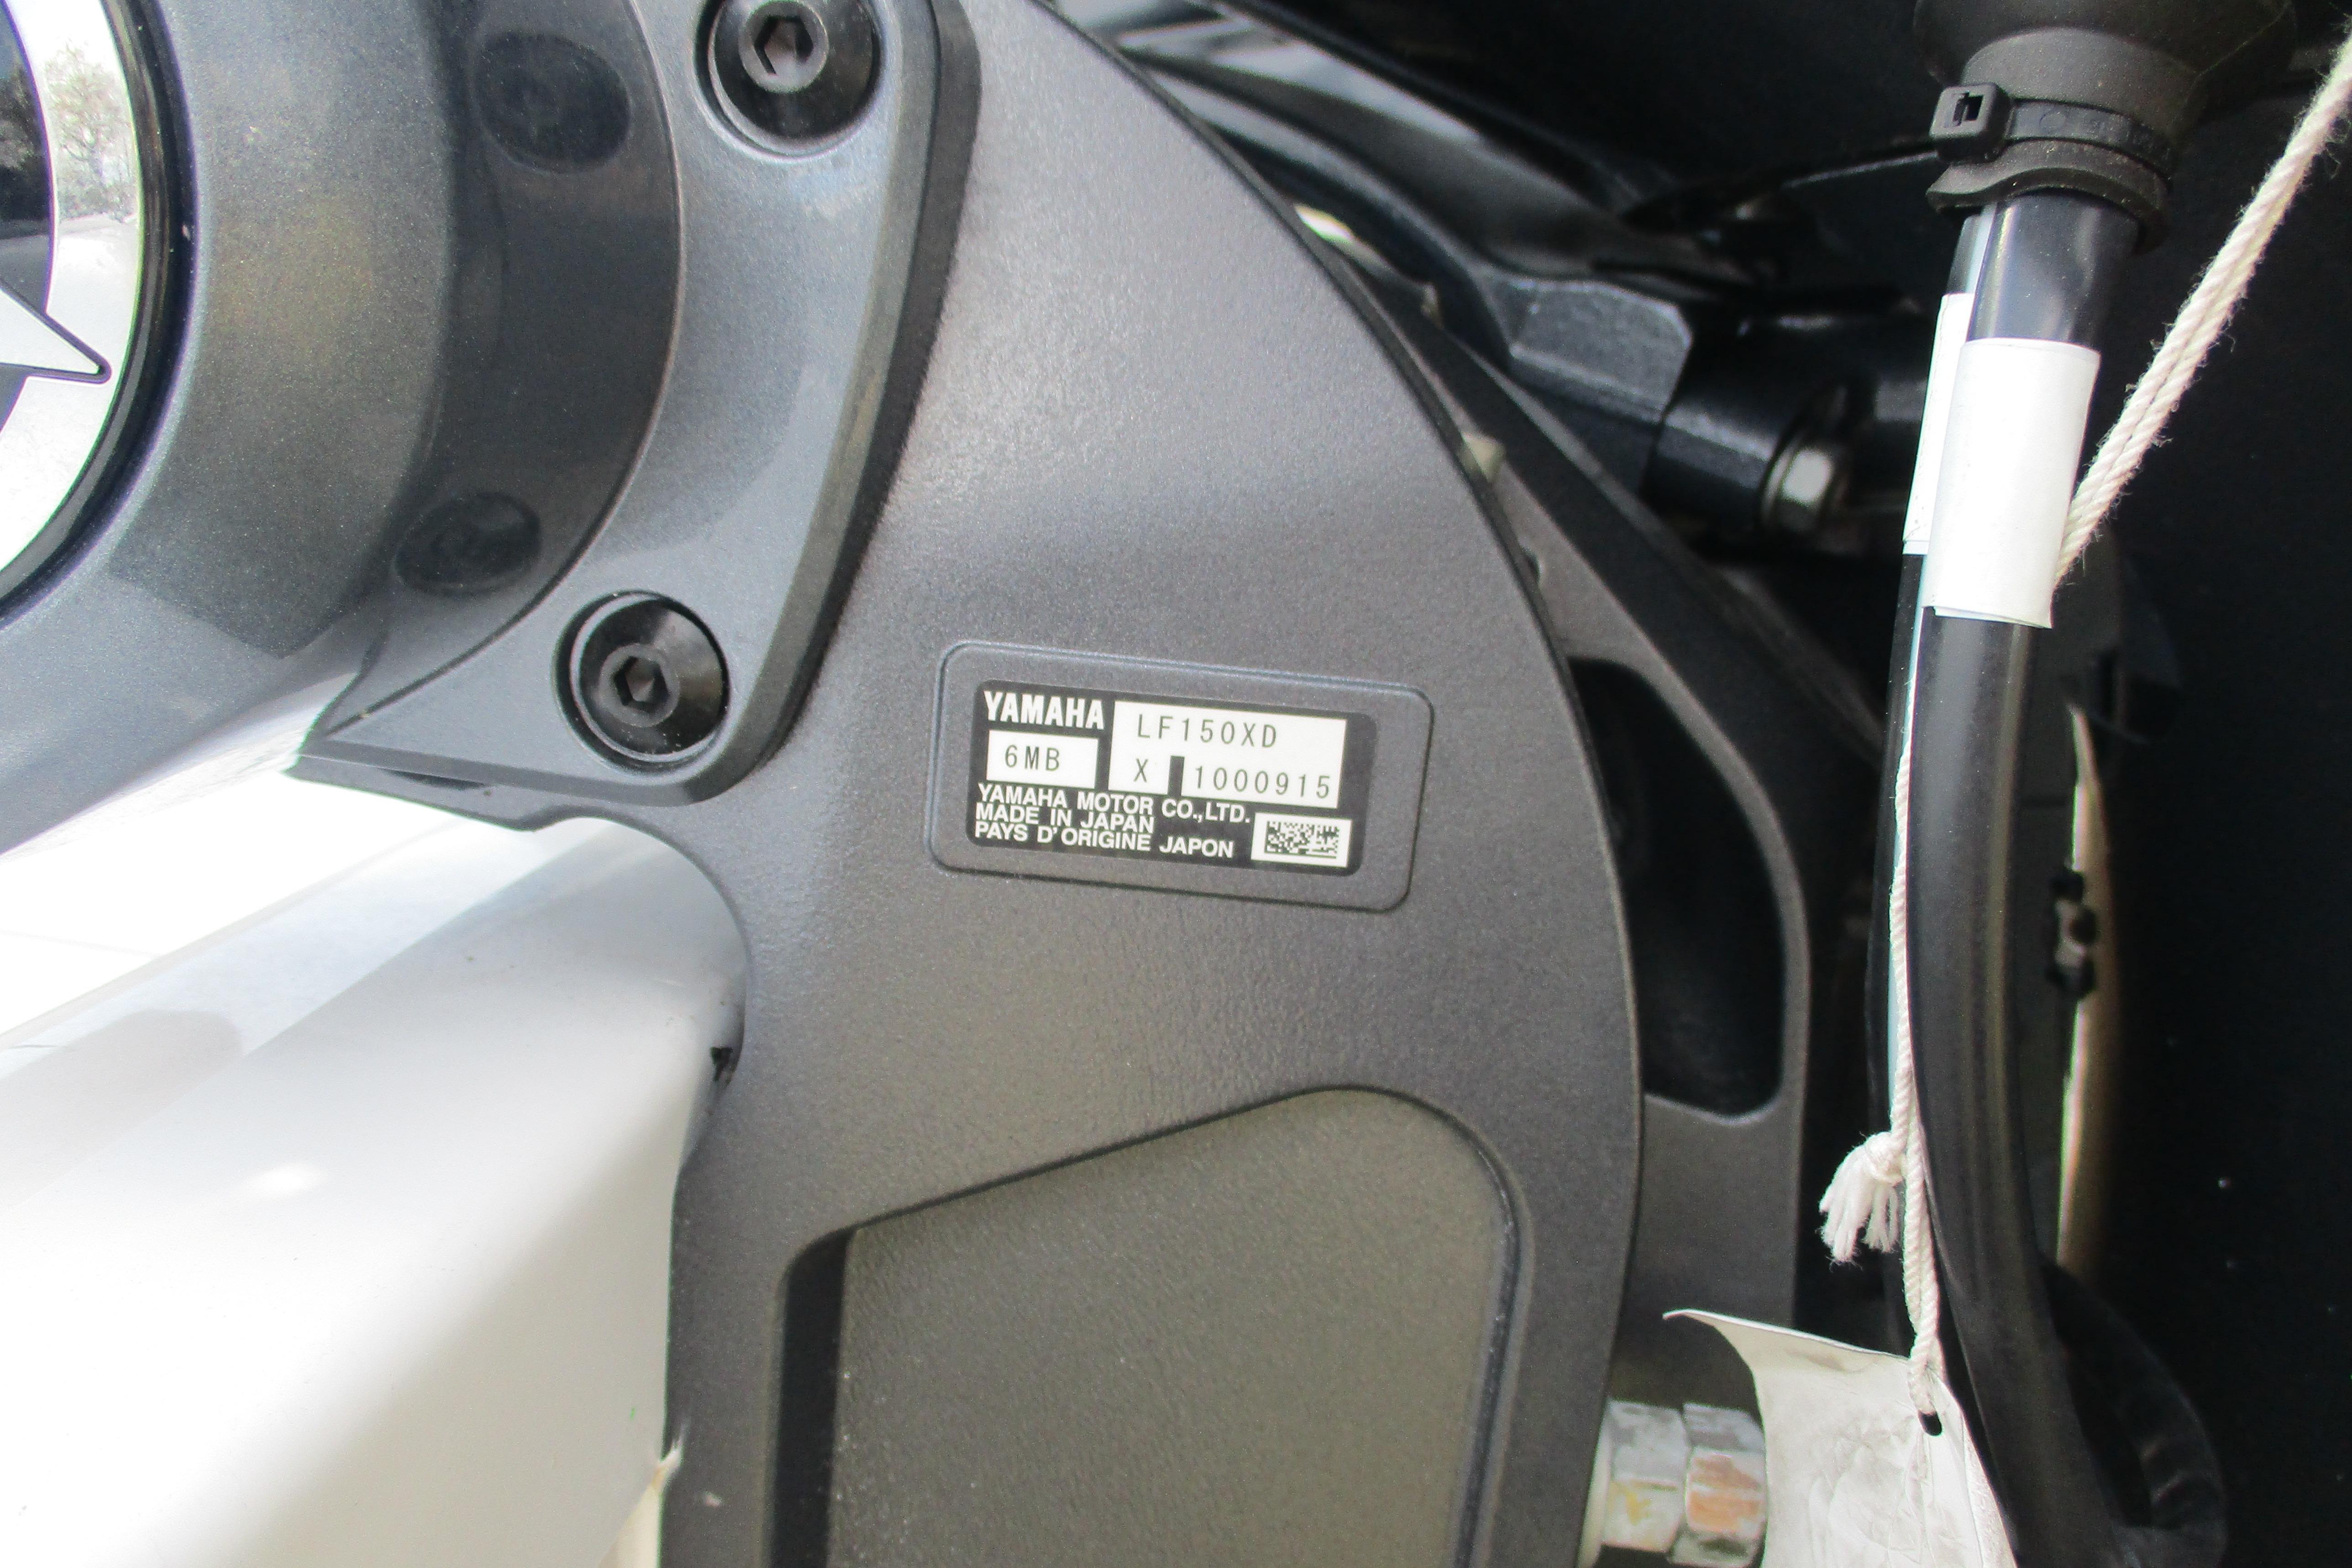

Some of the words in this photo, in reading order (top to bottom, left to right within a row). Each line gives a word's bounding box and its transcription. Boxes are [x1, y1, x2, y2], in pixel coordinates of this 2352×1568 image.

[984, 691, 1104, 730] YAMAHA
[1137, 713, 1277, 748] LF150XD
[1005, 745, 1060, 771] 6MB
[1133, 758, 1149, 782] X
[1195, 766, 1330, 799] 1000915
[977, 782, 1067, 808] YAMAHA
[1076, 791, 1155, 815] MOTOR
[975, 802, 1040, 824] MADE
[1050, 808, 1072, 827] IN
[1080, 812, 1155, 834] JAPAN
[975, 821, 1028, 842] PAYS
[1159, 836, 1233, 858] JAPON
